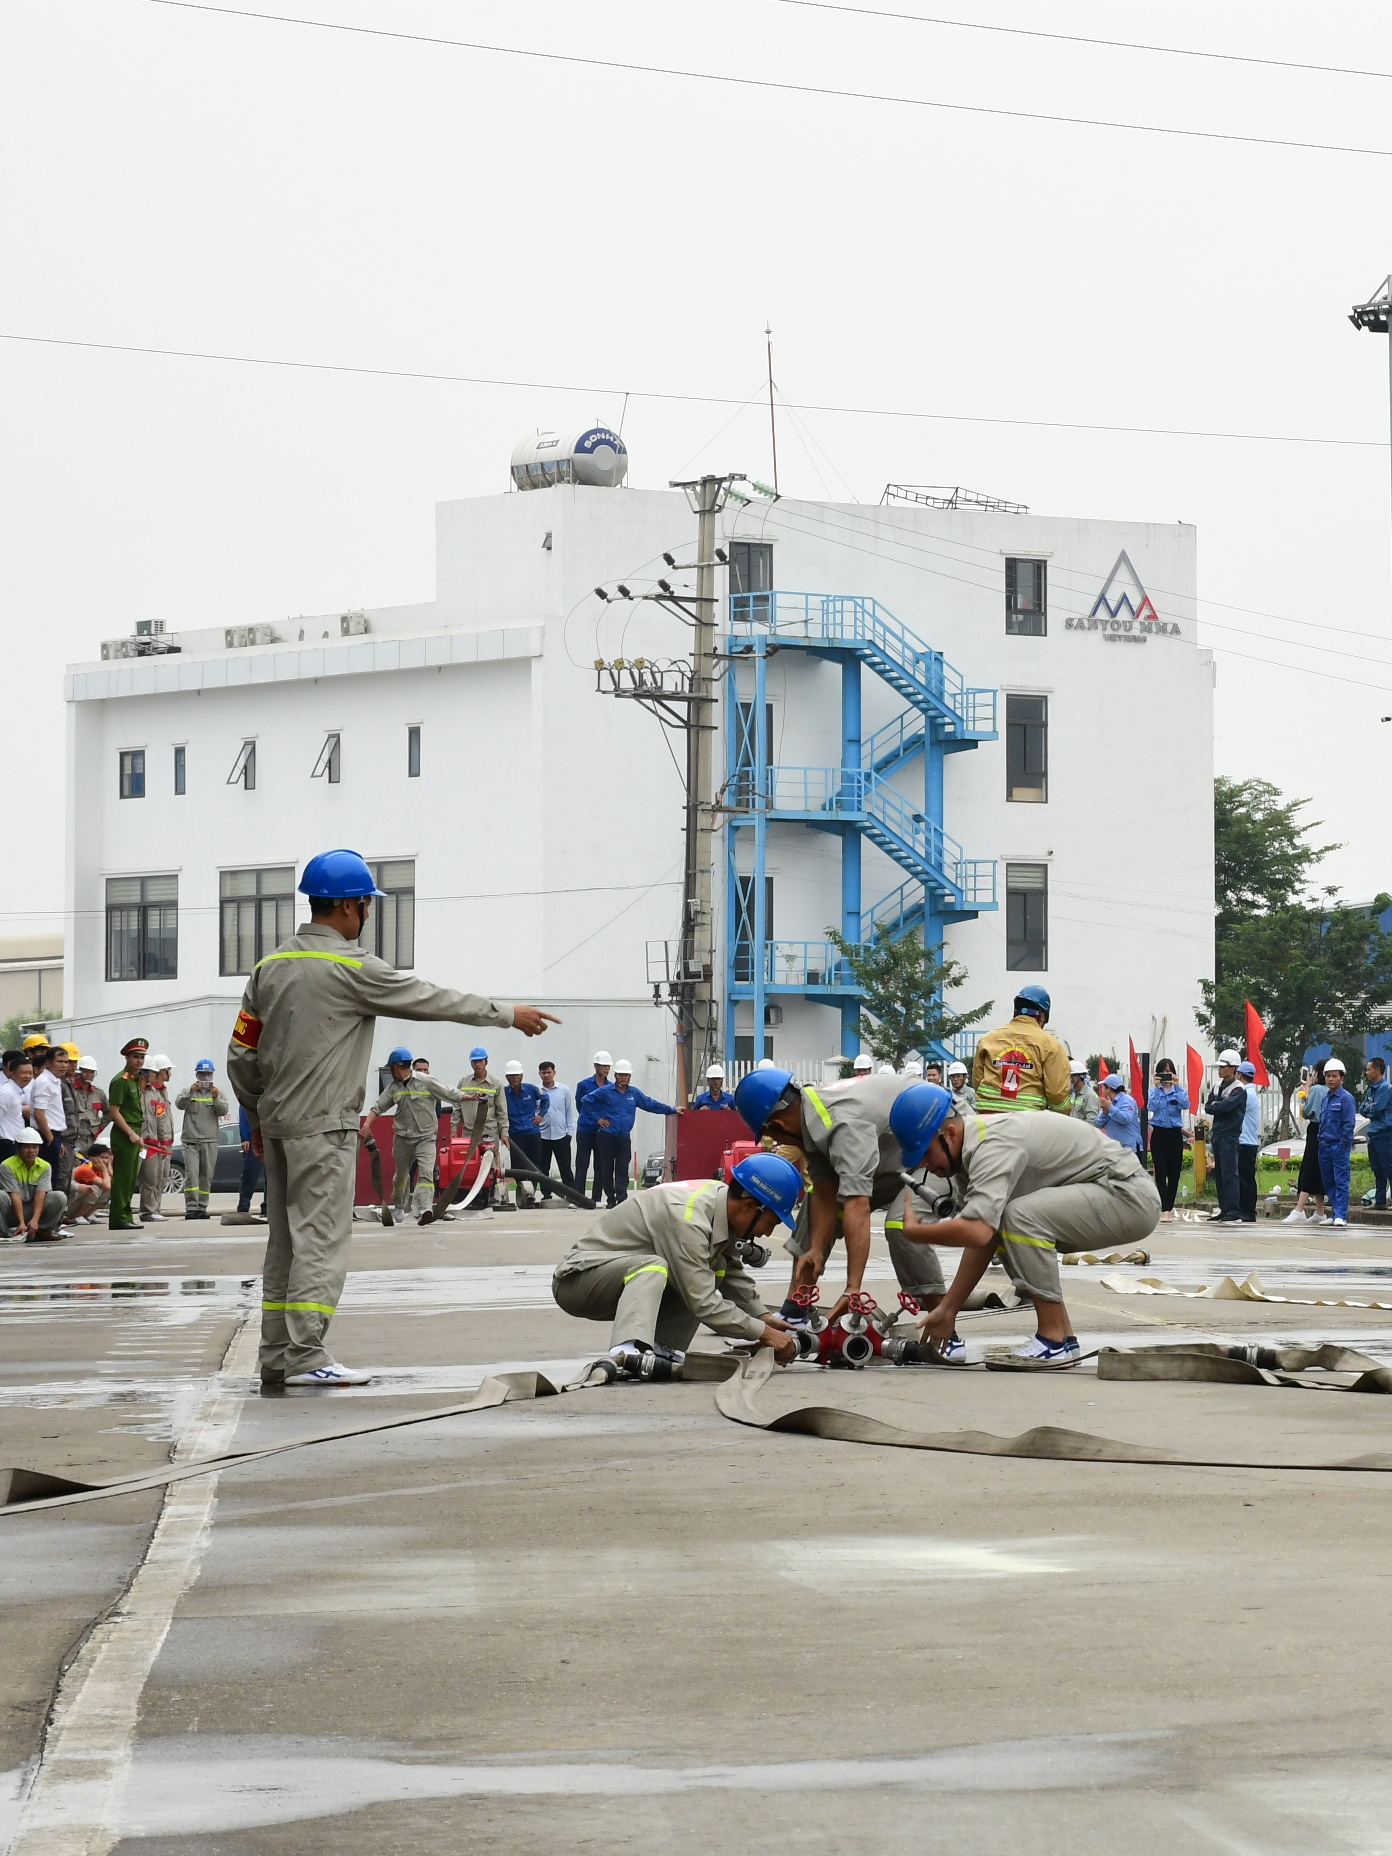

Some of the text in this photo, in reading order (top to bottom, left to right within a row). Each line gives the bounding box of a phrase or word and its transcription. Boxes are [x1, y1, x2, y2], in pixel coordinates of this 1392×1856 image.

[1065, 618, 1182, 635] SANYOU MMA
[1004, 1069, 1018, 1091] 4
